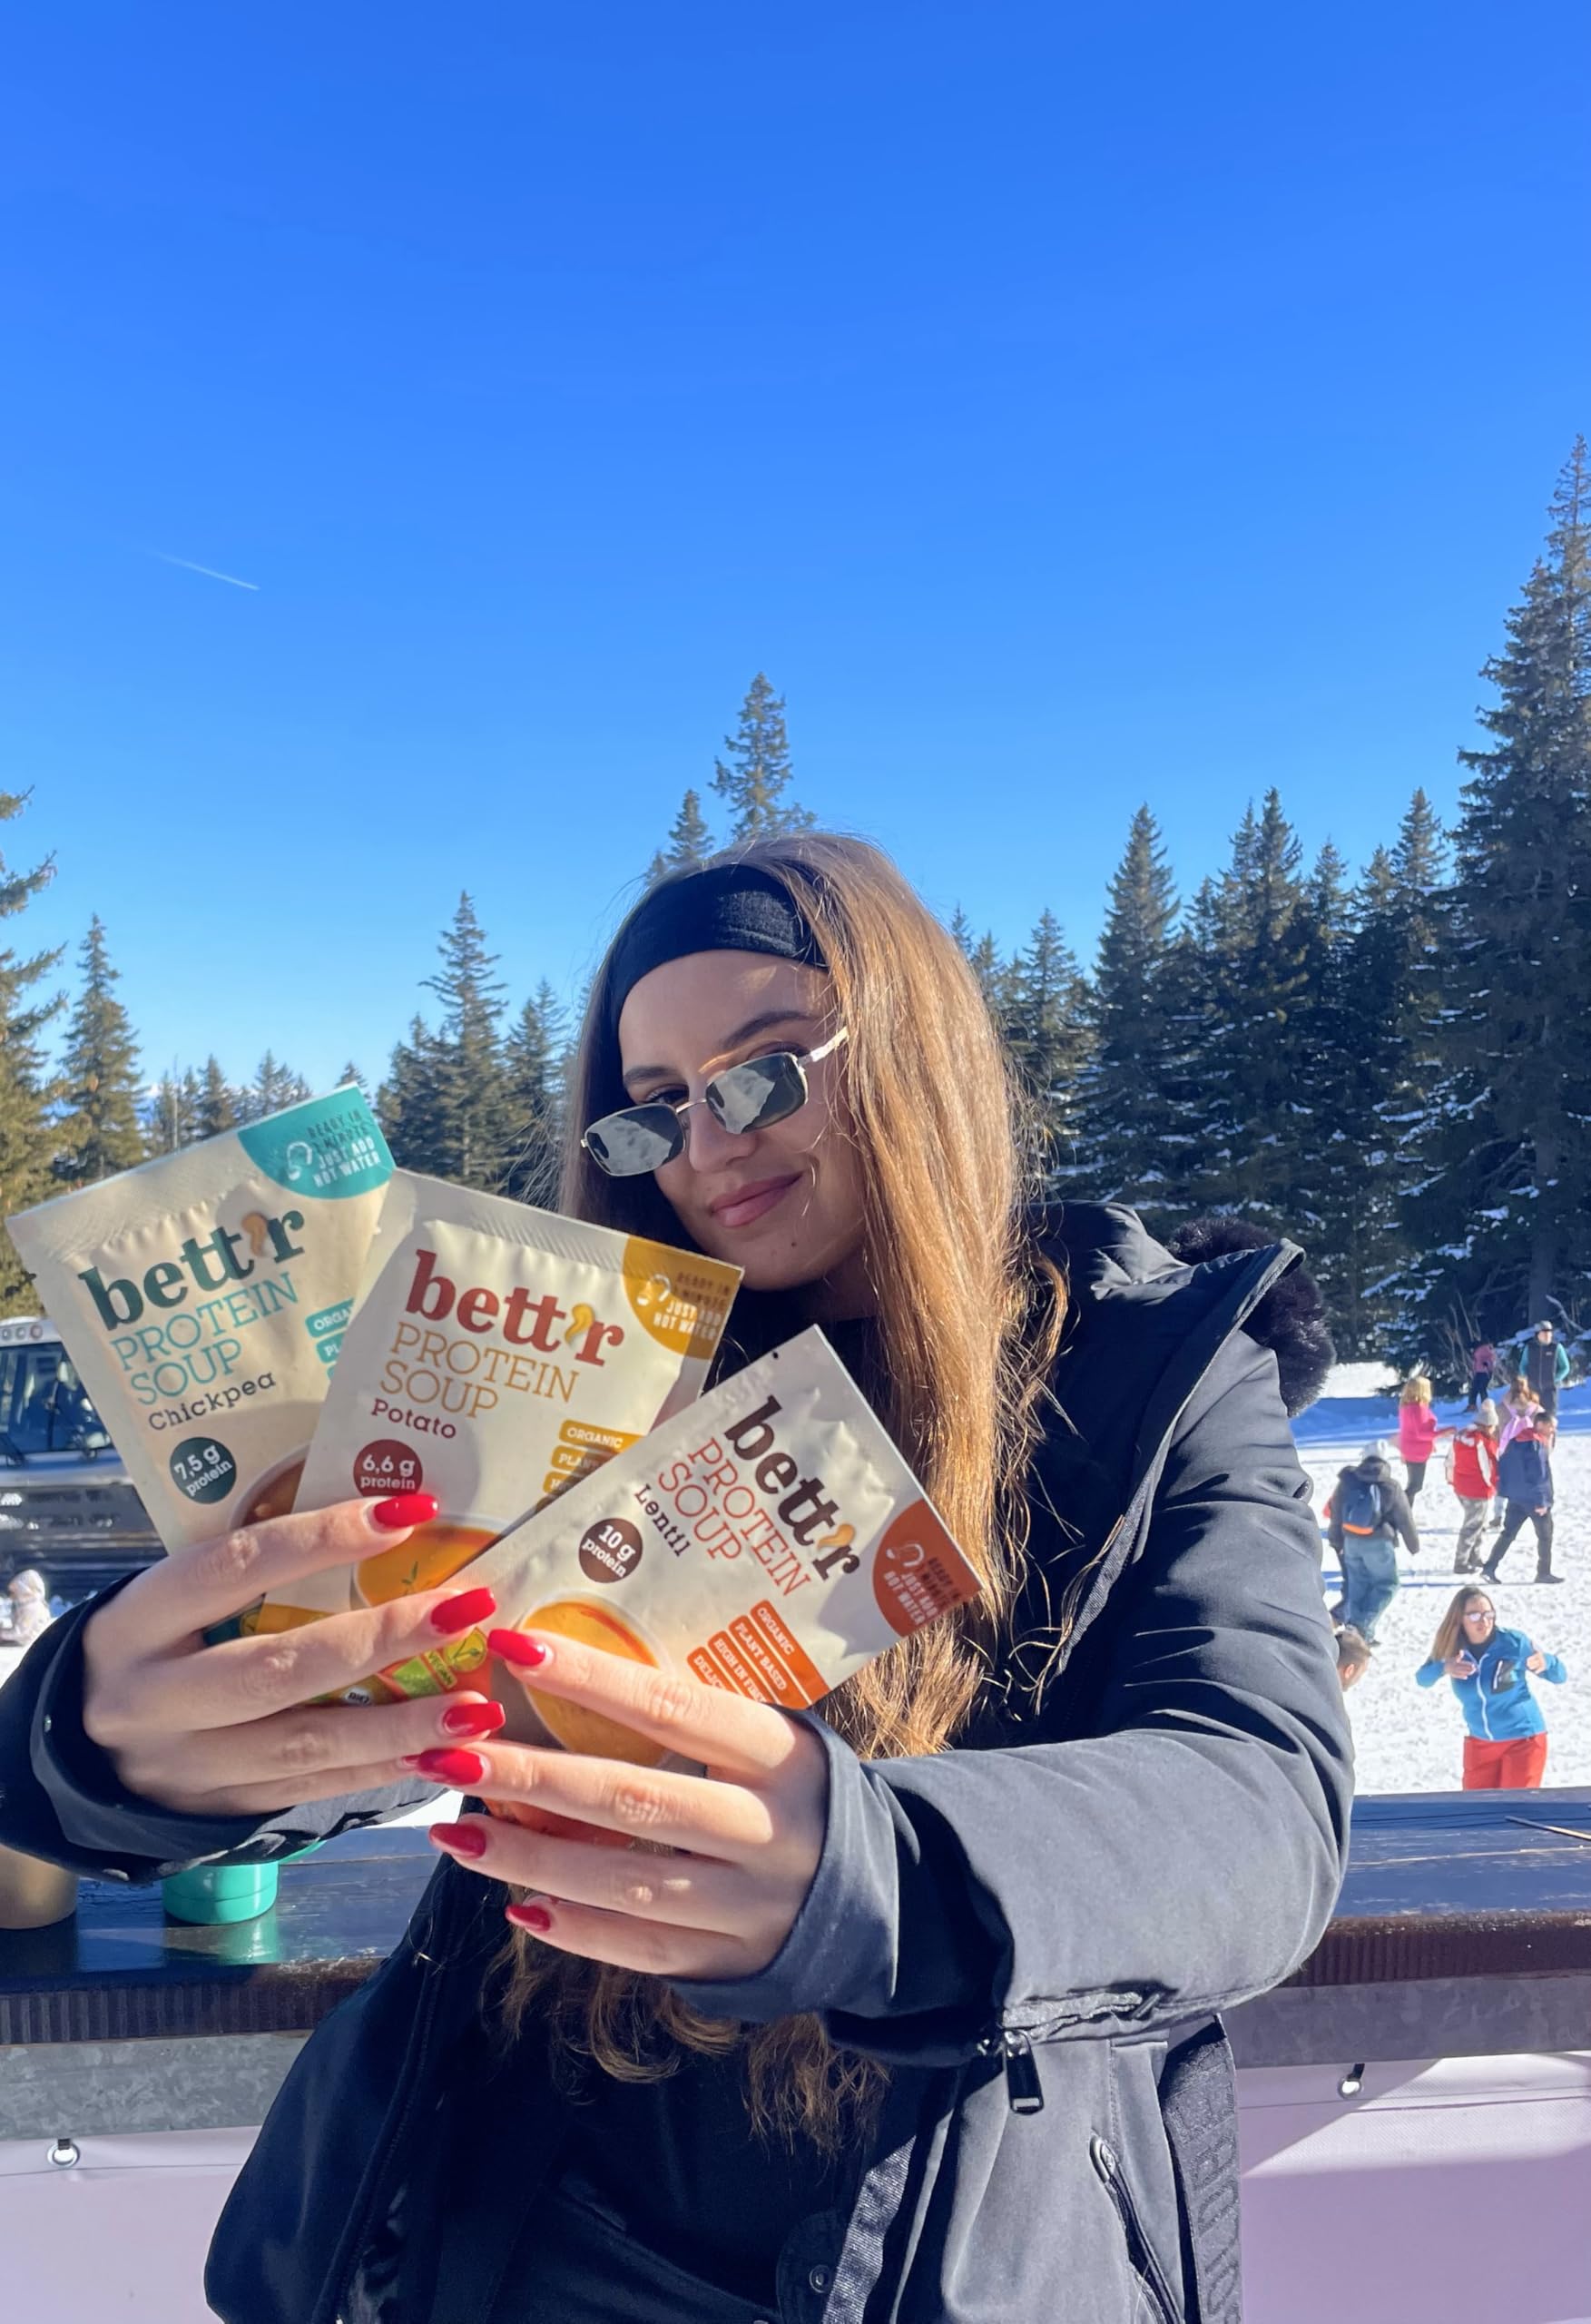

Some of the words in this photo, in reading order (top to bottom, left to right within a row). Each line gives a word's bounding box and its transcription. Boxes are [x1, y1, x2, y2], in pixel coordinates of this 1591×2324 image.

[313, 1167, 339, 1187] HOT
[339, 1150, 380, 1177] WATER
[319, 1146, 349, 1169] JUST
[351, 1136, 375, 1157] ADD
[110, 1272, 299, 1372] PROTEIN
[313, 1308, 349, 1331] ORGA
[653, 1312, 678, 1330] HOT
[666, 1299, 698, 1319] JUST
[131, 1338, 241, 1405] SOUP
[390, 1321, 580, 1403] PROTEIN
[148, 1372, 276, 1431] Chickpea
[380, 1360, 499, 1418] SOUP
[371, 1398, 457, 1439] Potato
[566, 1426, 624, 1450] ORGANIC
[173, 1454, 203, 1480] 7,5
[202, 1444, 221, 1465] g
[186, 1460, 232, 1497] protein
[362, 1454, 394, 1475] 6,6
[399, 1459, 416, 1478] g
[360, 1475, 416, 1491] protein
[633, 1483, 691, 1557] Lentil
[658, 1462, 742, 1560] SOUP
[688, 1437, 811, 1596] PROTEIN
[582, 1539, 626, 1578] protein
[598, 1525, 623, 1549] 10
[616, 1544, 636, 1561] g
[900, 1572, 926, 1597] JUST
[898, 1591, 926, 1625] WATER
[757, 1607, 795, 1656] ORGANIC
[693, 1655, 725, 1689] DELIC
[713, 1638, 739, 1668] HIGH
[733, 1664, 748, 1680] IN
[735, 1622, 765, 1659] PLANT
[759, 1656, 788, 1690] BASED
